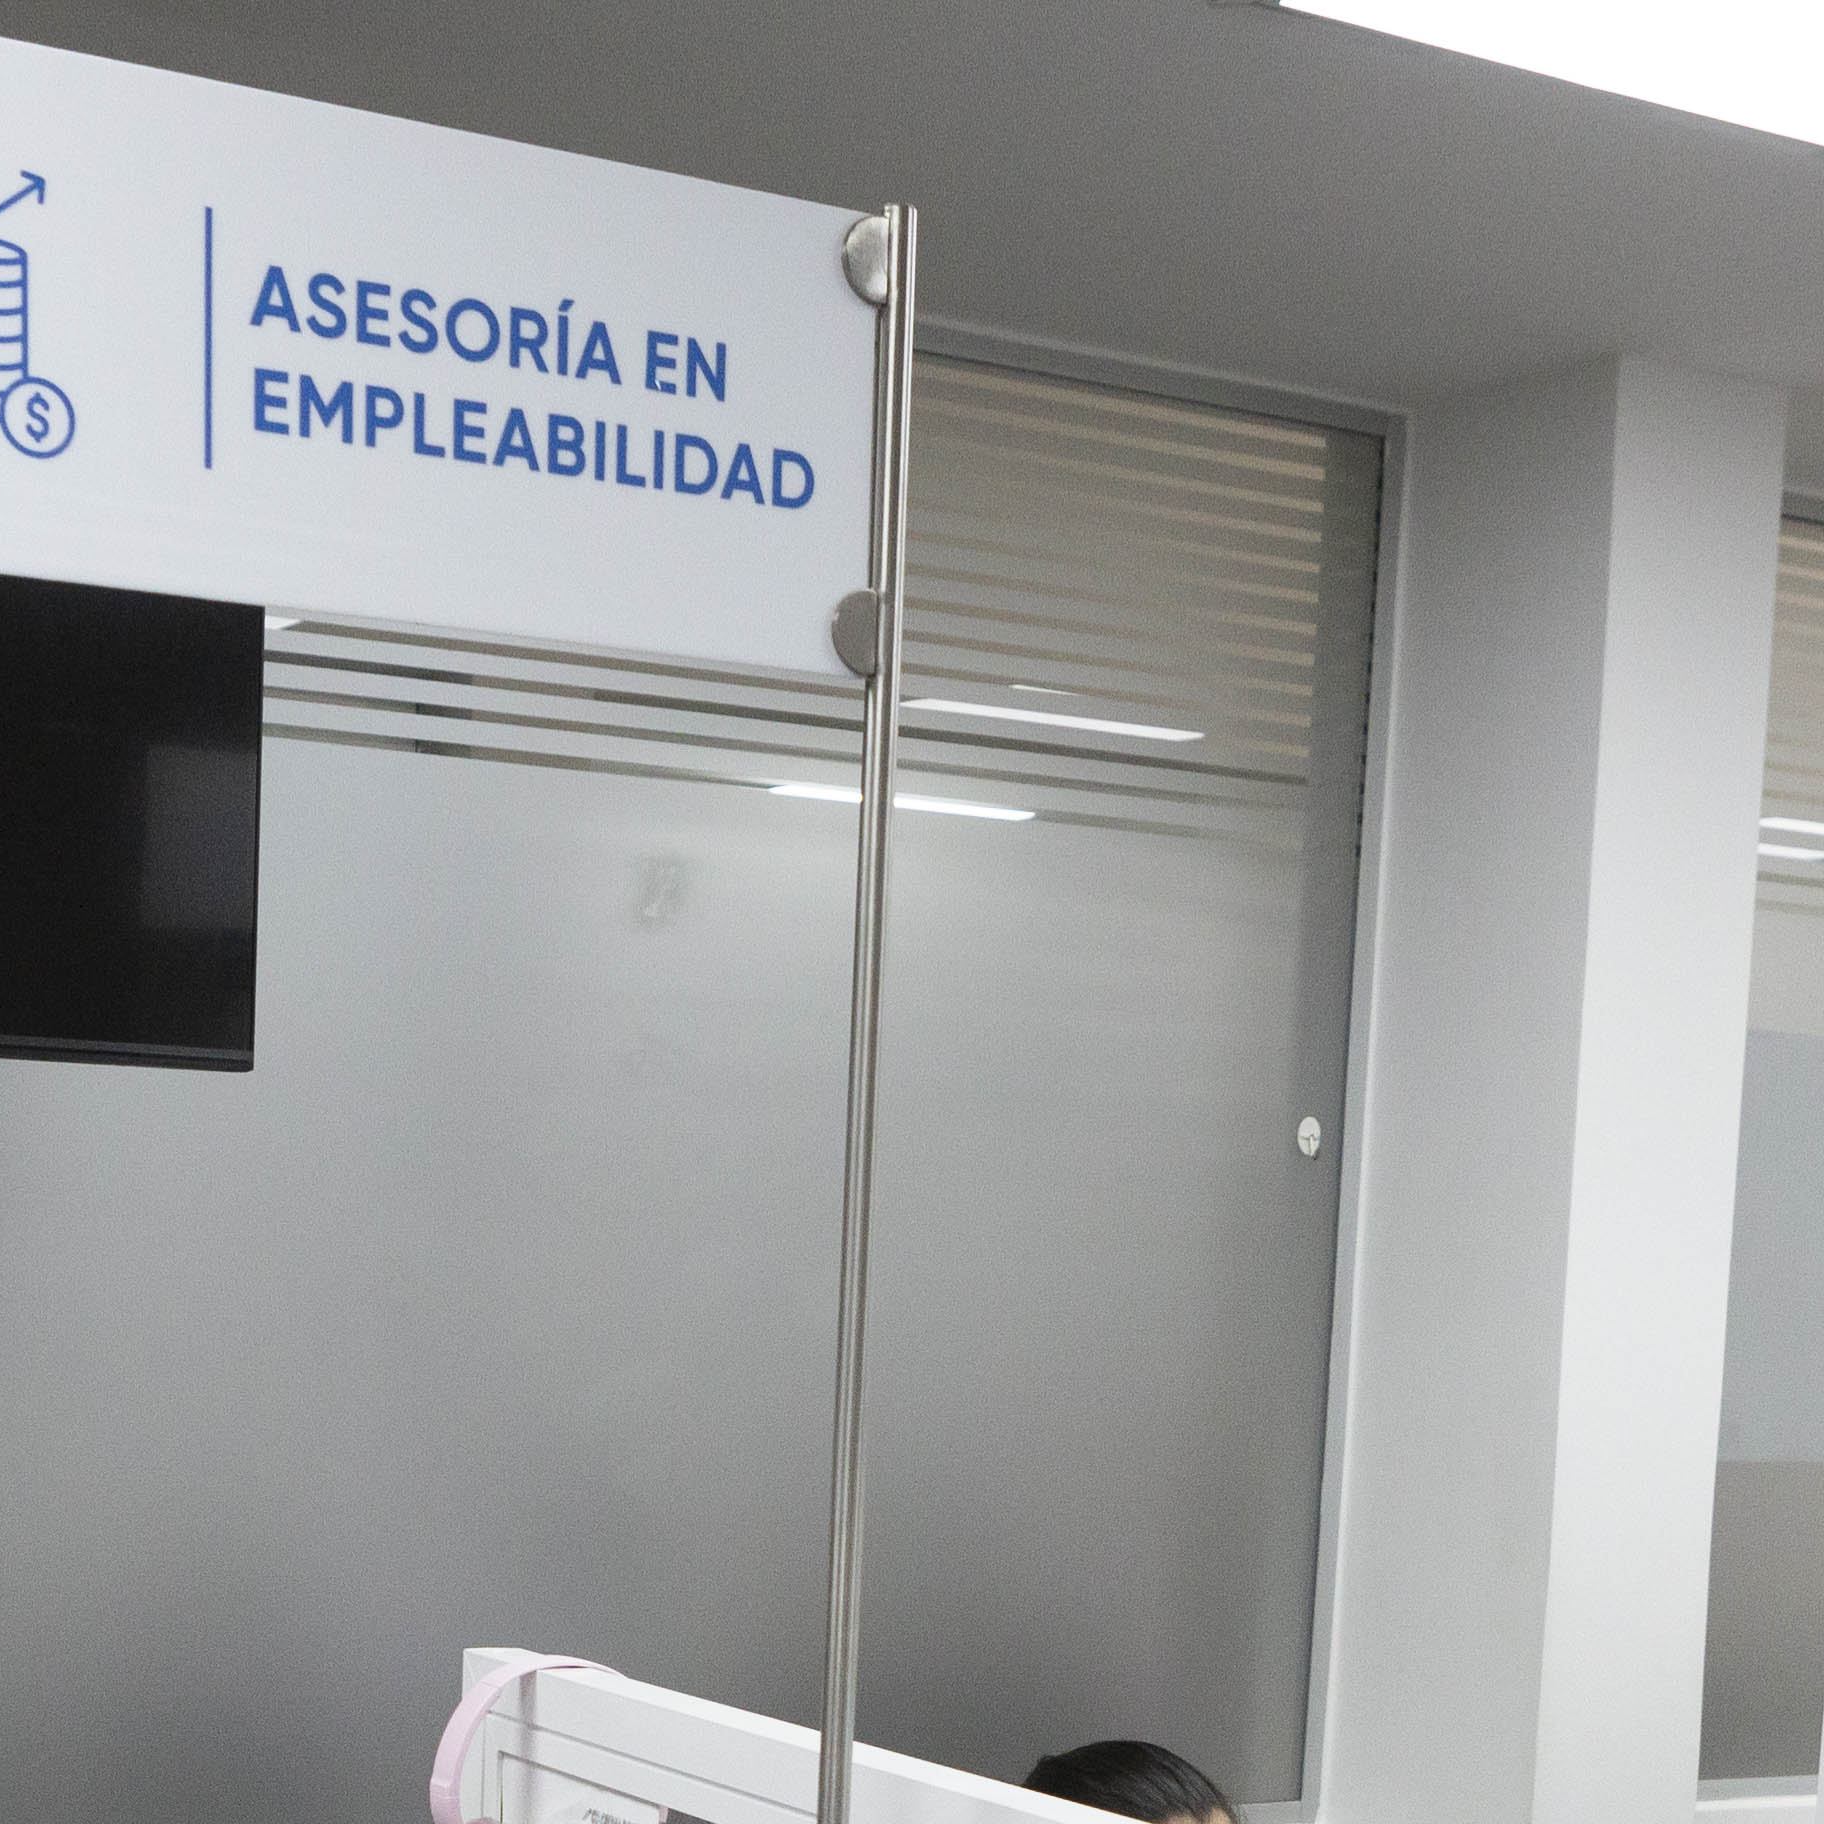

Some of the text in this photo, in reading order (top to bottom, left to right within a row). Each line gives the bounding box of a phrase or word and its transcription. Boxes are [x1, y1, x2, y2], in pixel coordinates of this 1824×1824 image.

[249, 265, 729, 404] ASESORÍA EN
[252, 366, 816, 512] EMPLEABILIDAD
